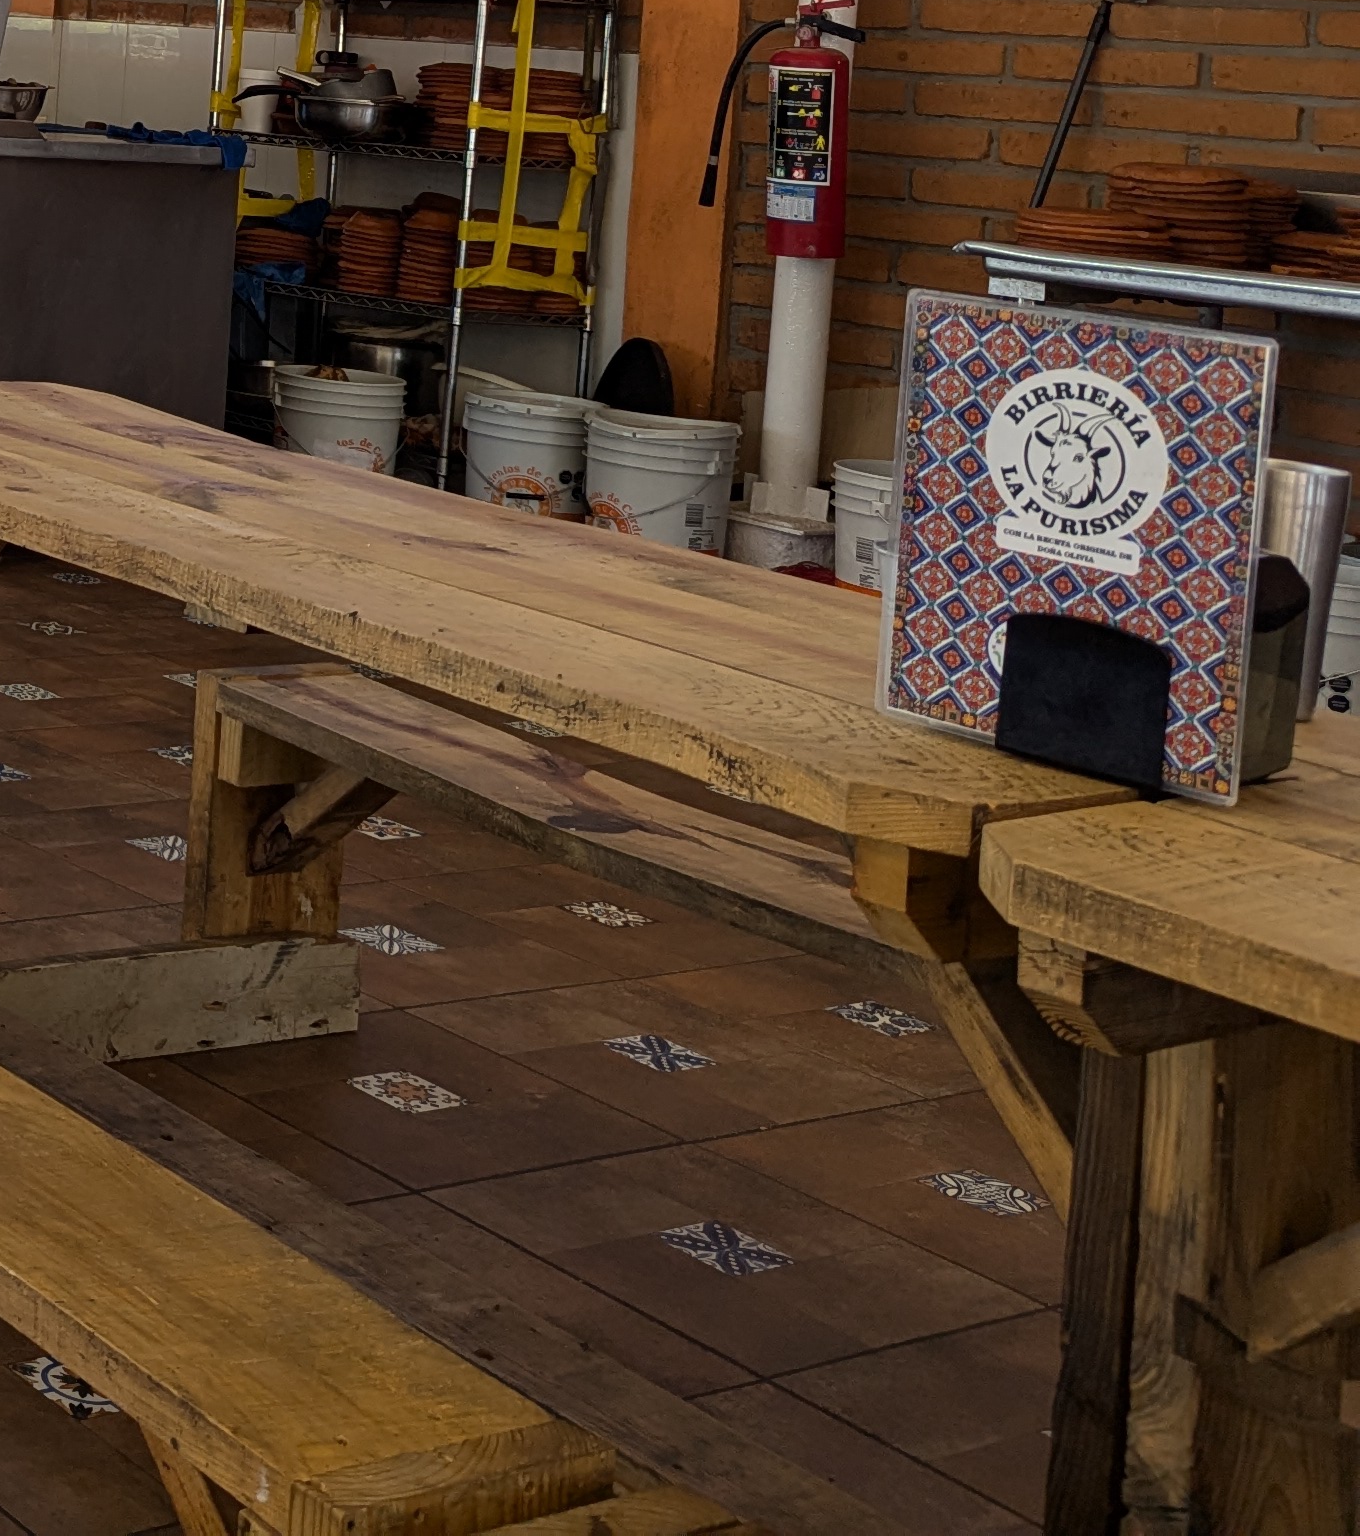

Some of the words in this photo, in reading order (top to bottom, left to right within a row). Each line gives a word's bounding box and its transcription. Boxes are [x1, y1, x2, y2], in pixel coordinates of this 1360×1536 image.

[1004, 381, 1152, 449] BIRRIERÍA
[1000, 464, 1025, 500] LA
[1020, 489, 1149, 536] PURISIMA
[1003, 527, 1022, 538] CON
[1023, 531, 1035, 541] LA
[1036, 534, 1072, 549] RECETA
[1073, 542, 1118, 558] ORIGINAL
[1036, 545, 1062, 557] DOÑA
[1064, 550, 1095, 564] OLIVIA
